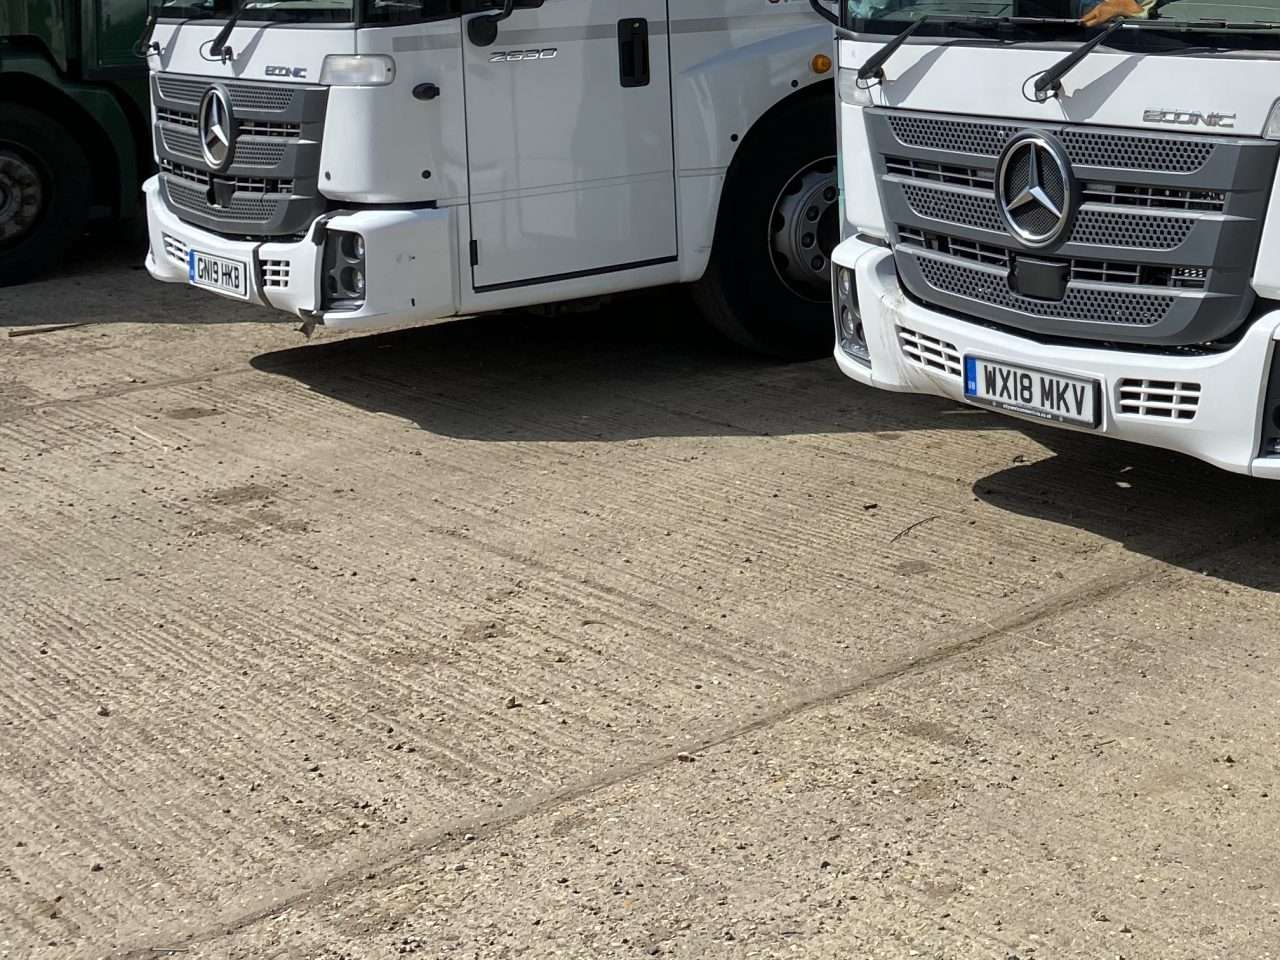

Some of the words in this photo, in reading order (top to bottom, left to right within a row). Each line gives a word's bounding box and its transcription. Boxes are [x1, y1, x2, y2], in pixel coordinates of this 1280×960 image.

[489, 47, 558, 63] 2630
[265, 65, 307, 79] ECONIC
[1142, 109, 1236, 128] ECONIC
[221, 262, 240, 289] HKB
[983, 364, 1033, 404] WX18
[1039, 376, 1086, 416] MKV
